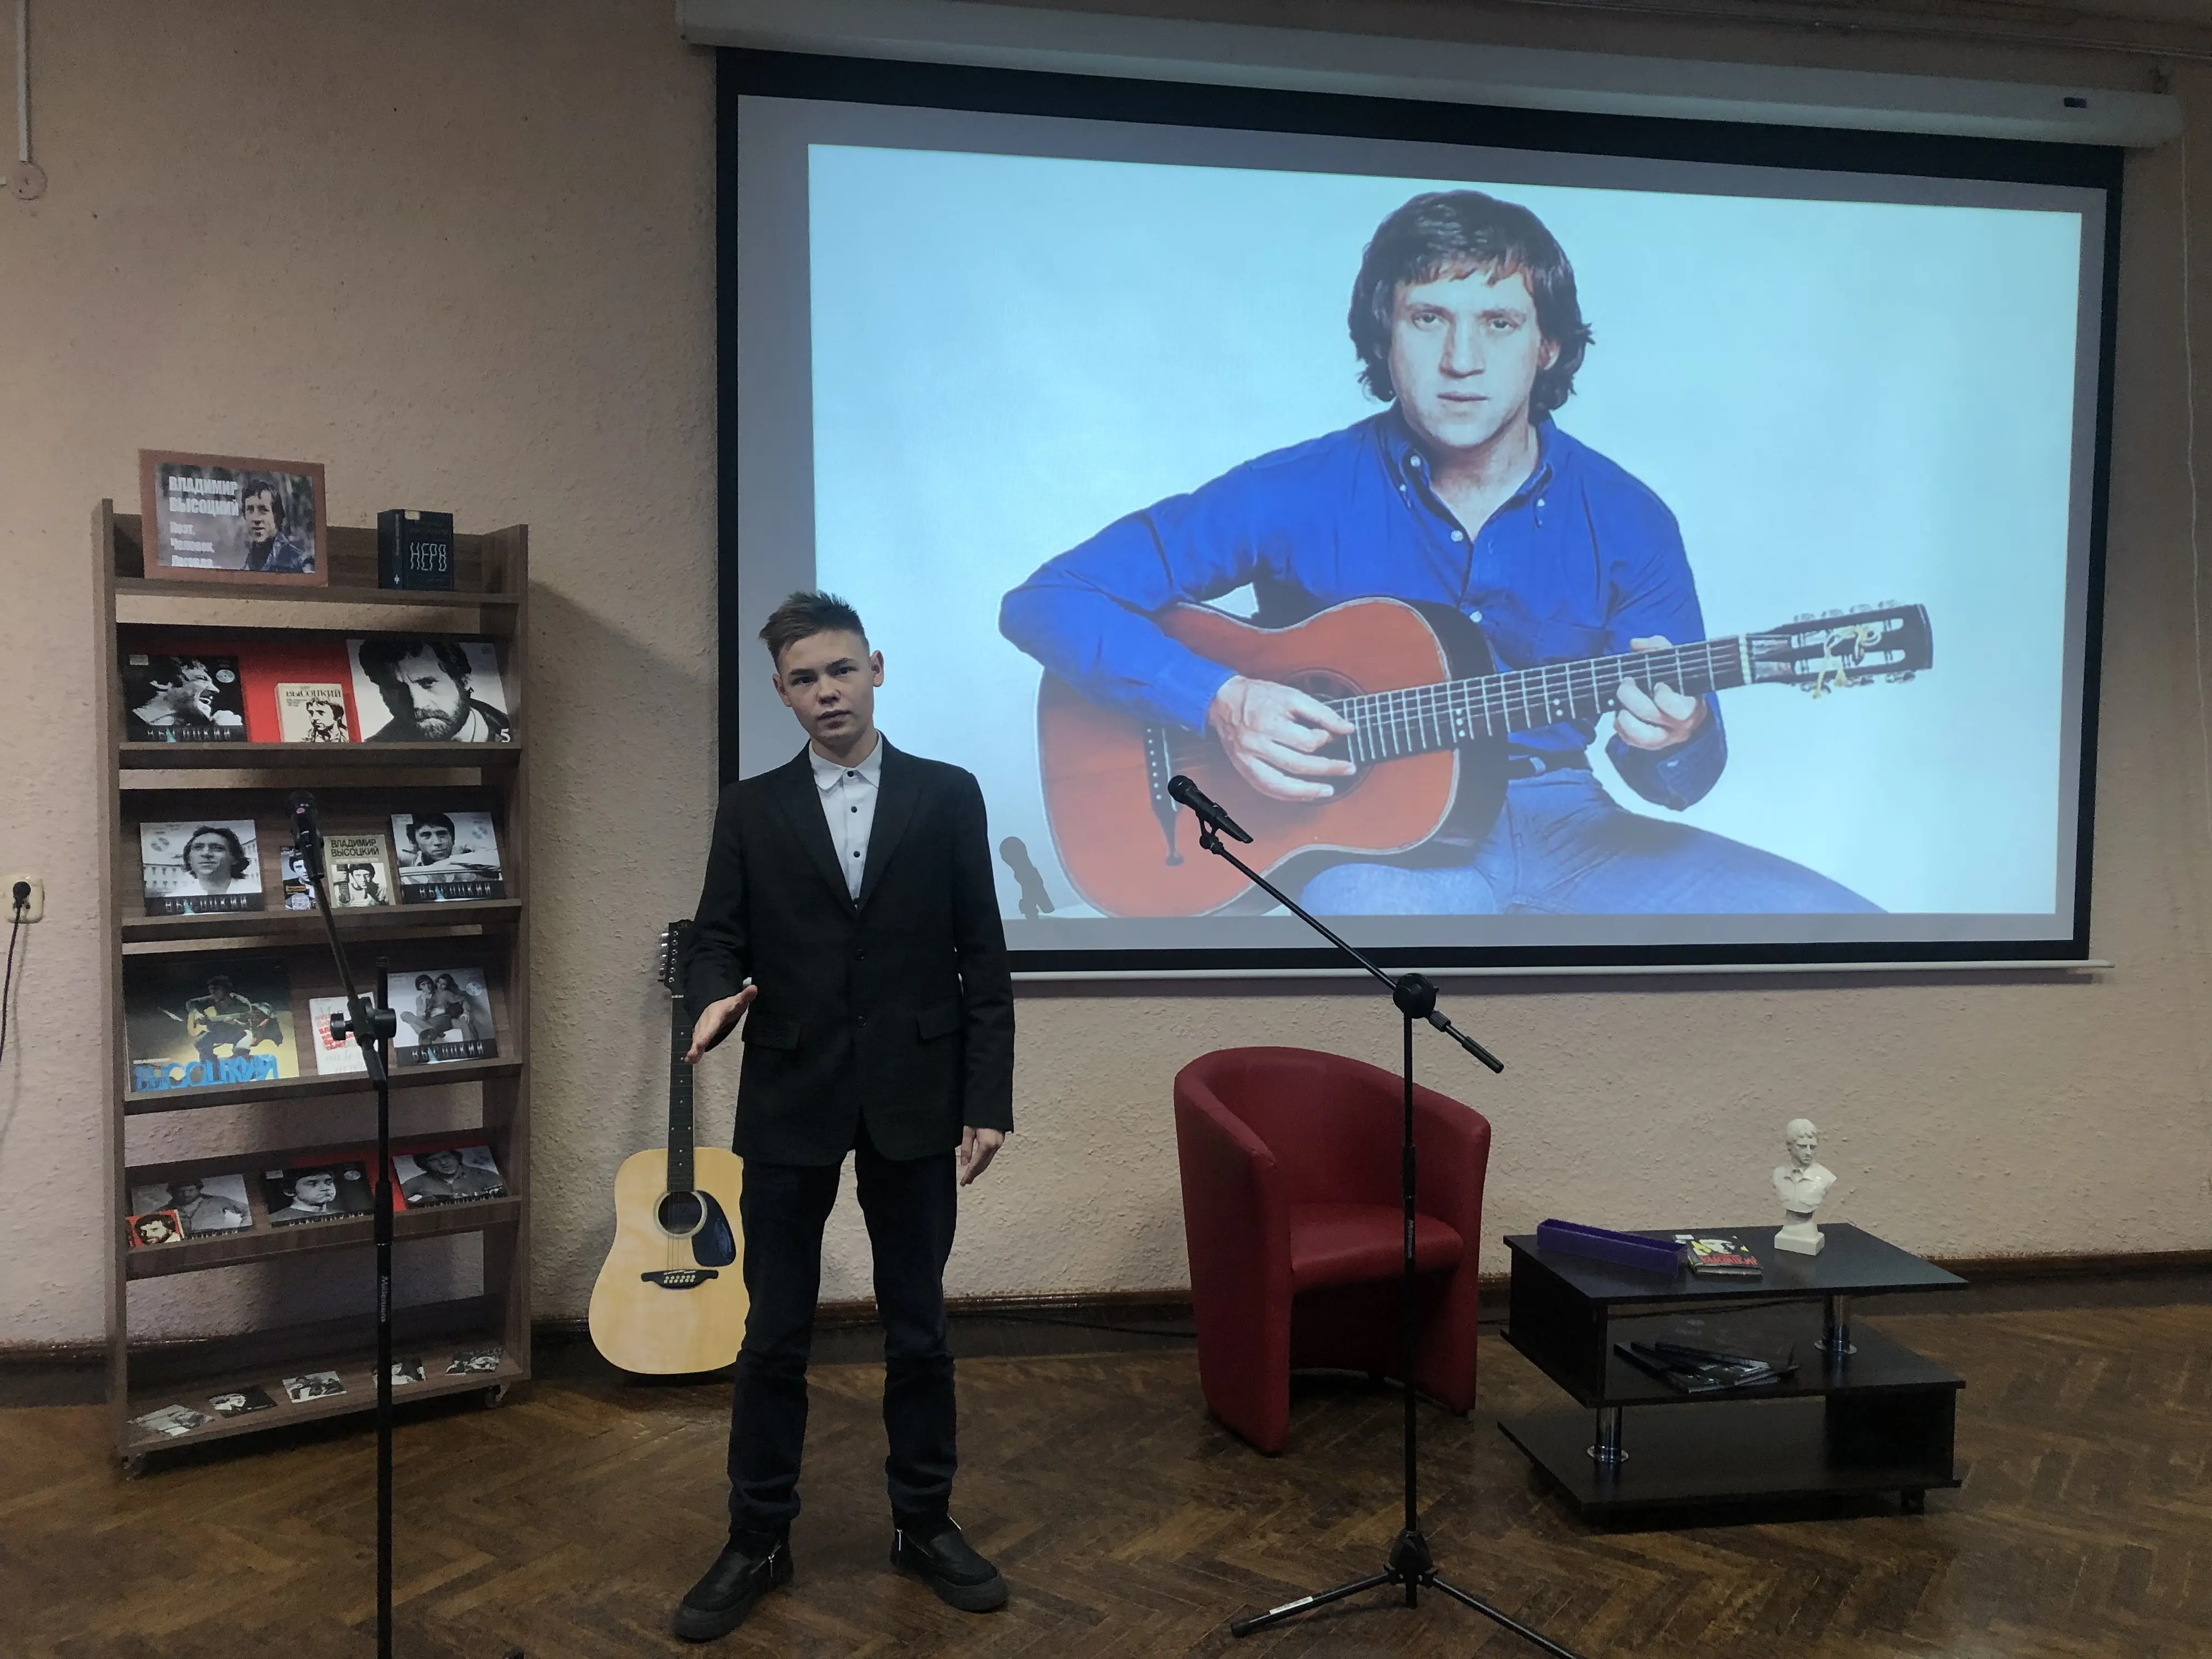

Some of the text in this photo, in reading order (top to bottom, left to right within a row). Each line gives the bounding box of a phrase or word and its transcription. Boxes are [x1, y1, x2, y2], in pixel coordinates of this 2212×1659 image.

[168, 476, 238, 495] ВЛАДИМИР
[168, 497, 239, 517] ВЫСОЦКИЙ
[410, 542, 447, 572] НЕРВ
[285, 689, 341, 698] ВЫСОЦКИЙ
[500, 728, 511, 743] 5
[330, 839, 376, 848] ВЛАДИМИР
[331, 846, 380, 857] ВЫСОЦКИЙ
